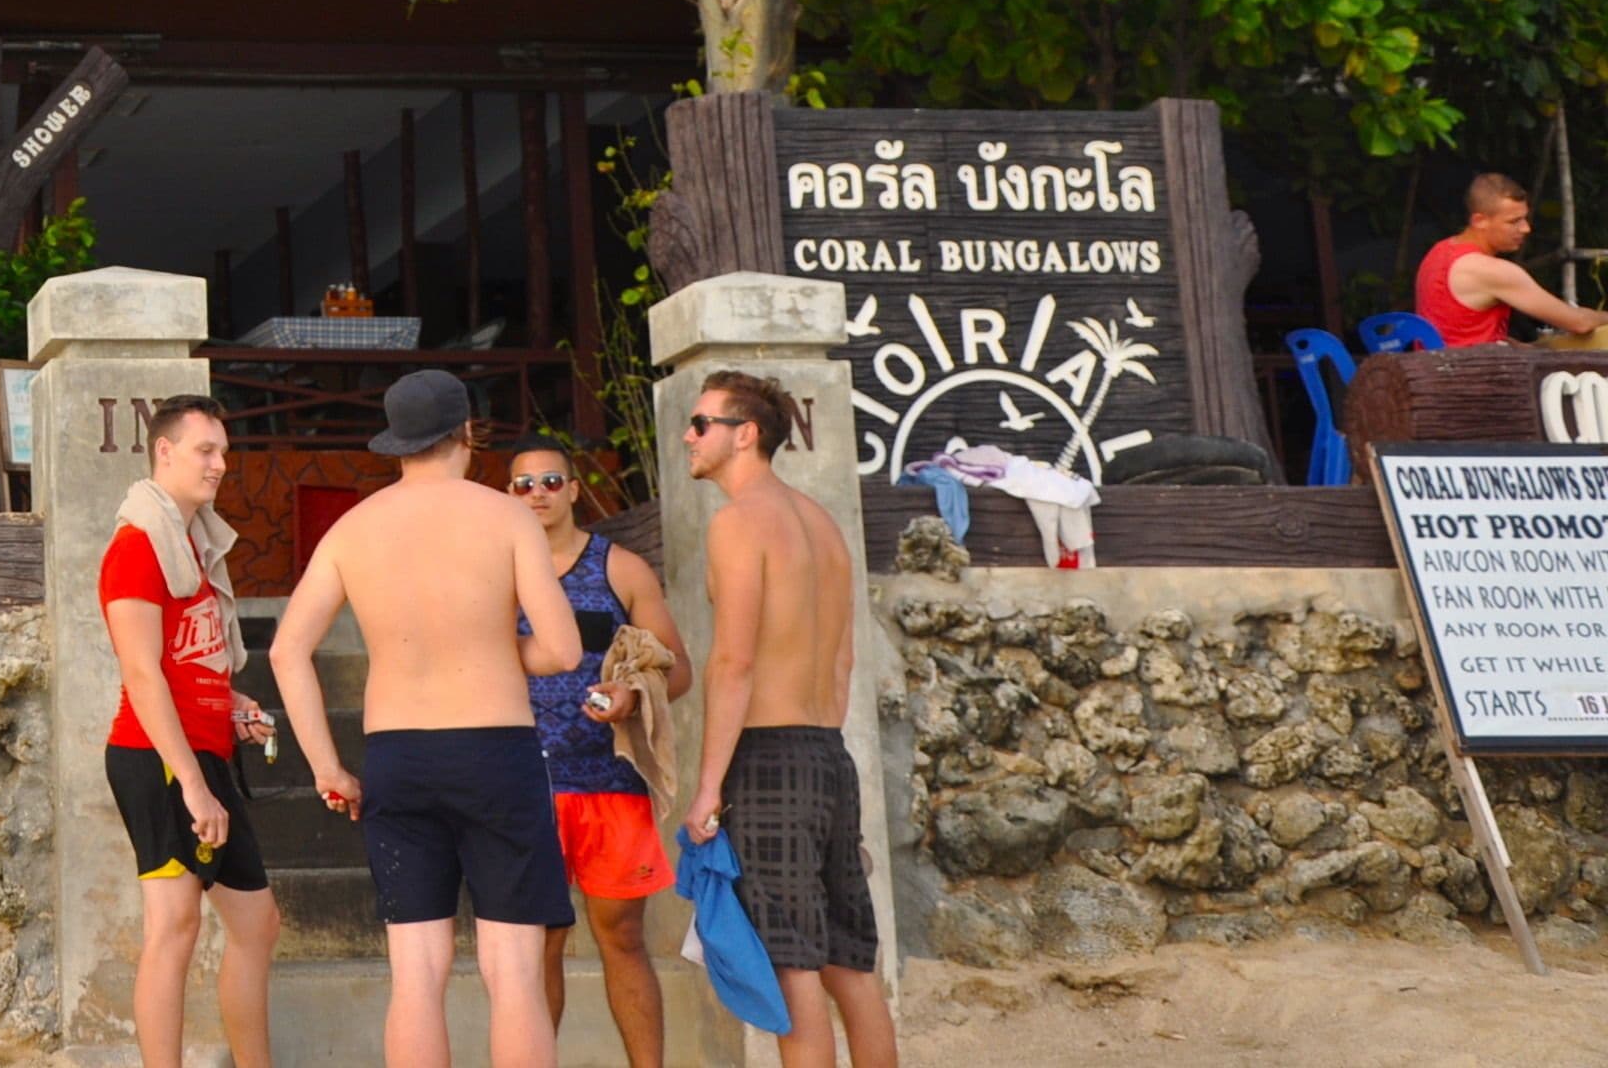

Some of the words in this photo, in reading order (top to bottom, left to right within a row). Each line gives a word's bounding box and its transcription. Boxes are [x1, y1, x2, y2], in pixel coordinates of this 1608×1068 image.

[12, 85, 91, 169] SHOWER
[788, 140, 936, 210] คอรัล
[958, 141, 1155, 212] บังกะโล
[794, 240, 920, 272] CORAL
[939, 241, 1160, 273] BUNGALOWS
[1396, 465, 1462, 500] CORAL
[1461, 466, 1581, 500] BUNGALOWS
[1411, 515, 1478, 539] HOT
[1510, 549, 1576, 572] ROOM
[1432, 585, 1474, 609] FAN
[1479, 585, 1543, 609] ROOM
[1545, 586, 1604, 609] WITH
[1444, 623, 1486, 637] ANY
[1495, 622, 1560, 637] ROOM
[1566, 622, 1606, 637] FOR
[1460, 657, 1498, 673] GET
[1507, 657, 1526, 673] IT
[1533, 657, 1605, 673] WHILE
[1465, 690, 1547, 716] STARTS
[1577, 695, 1599, 714] 16
